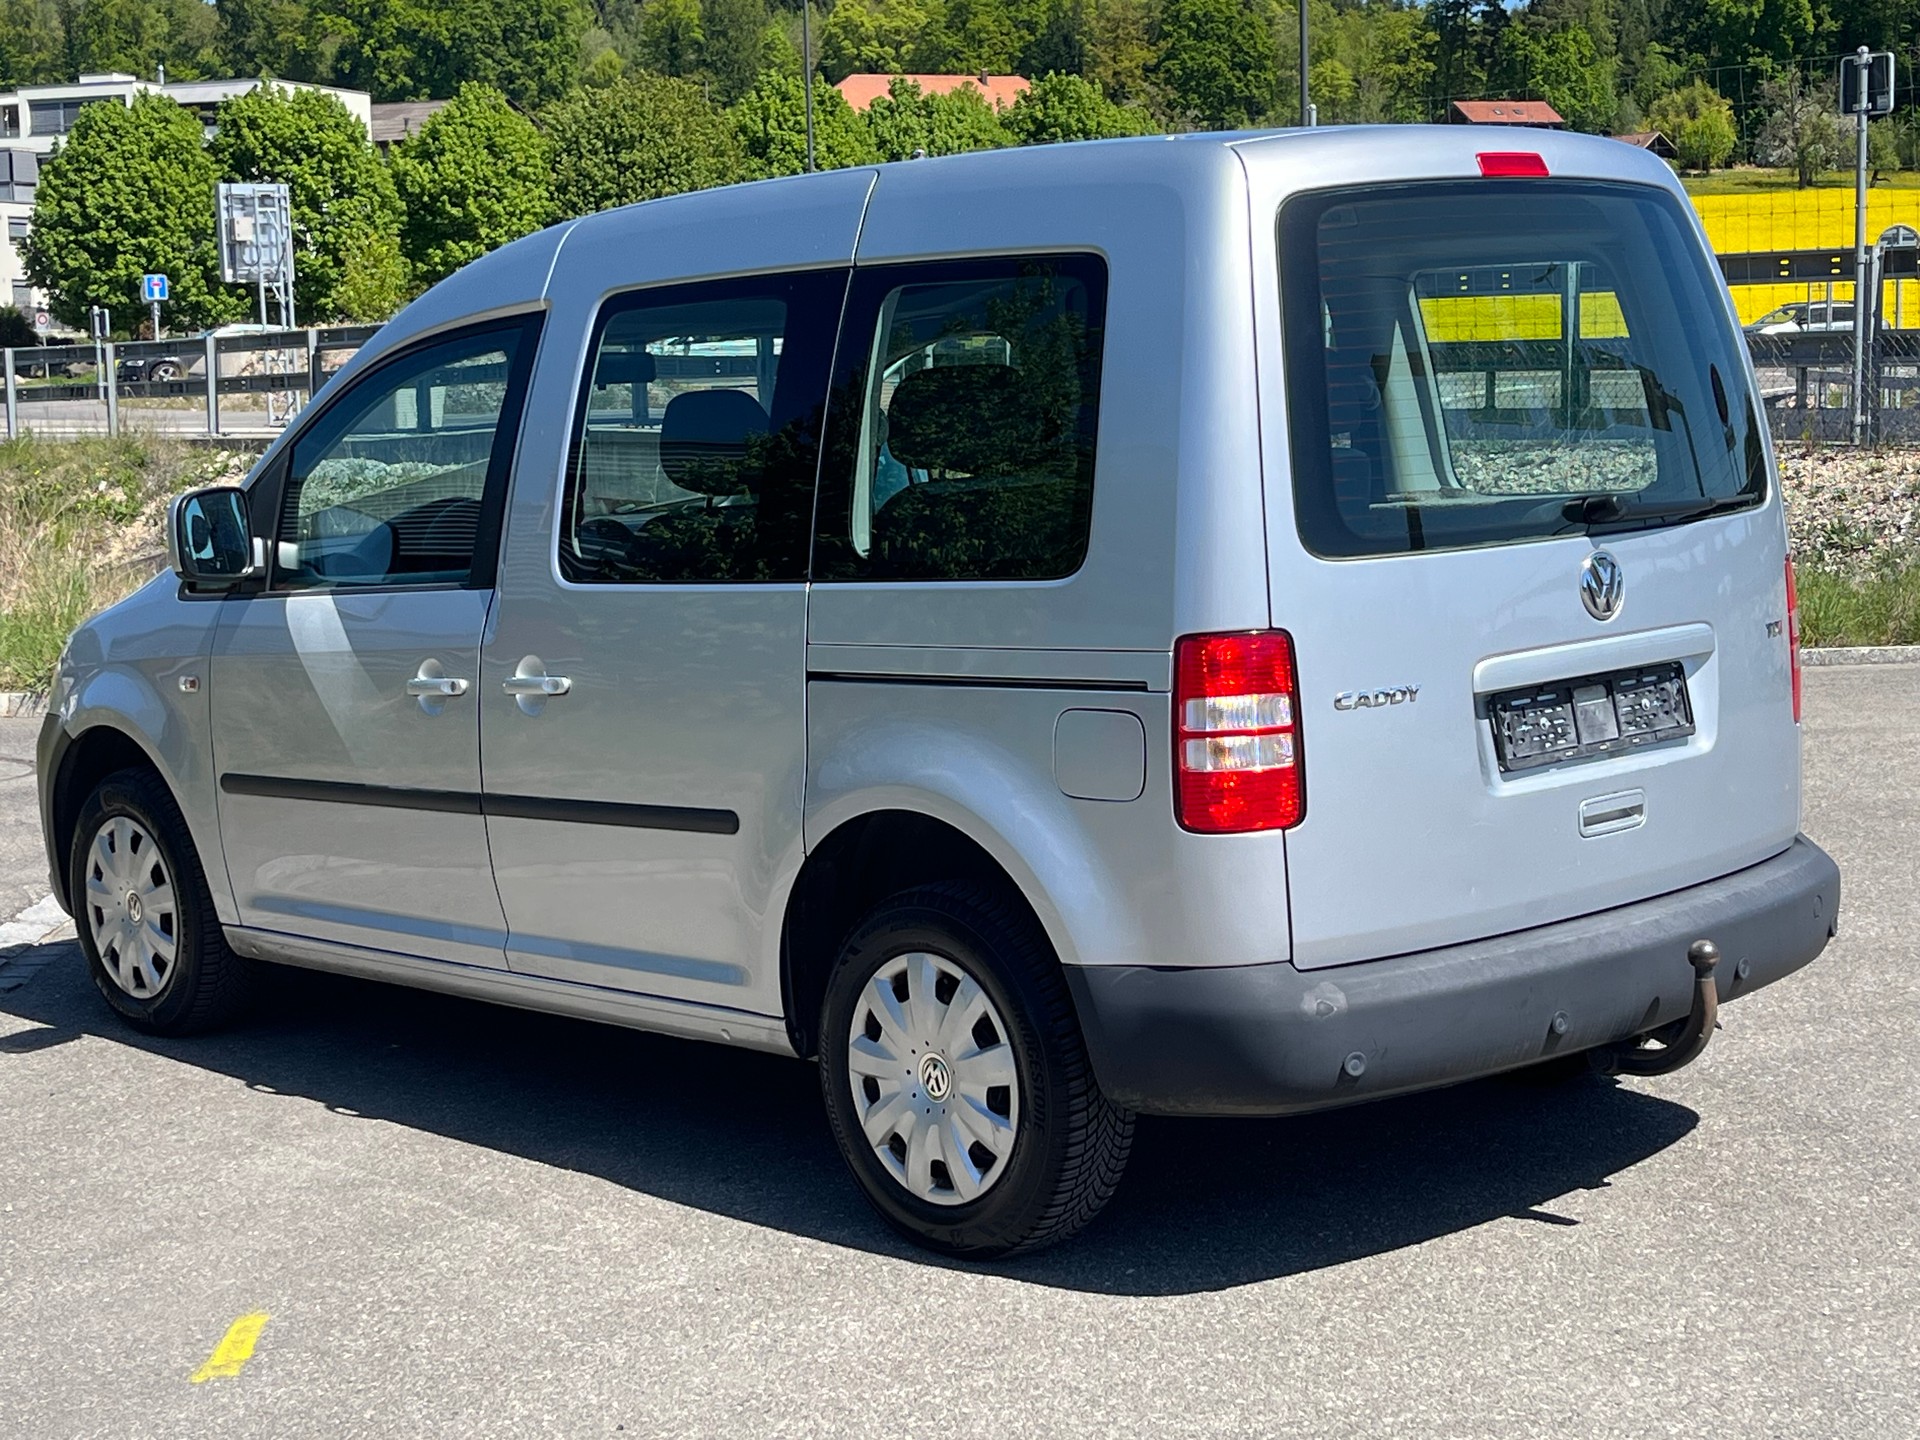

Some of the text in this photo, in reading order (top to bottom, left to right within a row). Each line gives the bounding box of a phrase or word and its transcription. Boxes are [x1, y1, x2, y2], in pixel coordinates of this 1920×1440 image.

[1580, 550, 1624, 621] VW
[1765, 619, 1783, 639] TDI
[1333, 684, 1421, 711] CADDY
